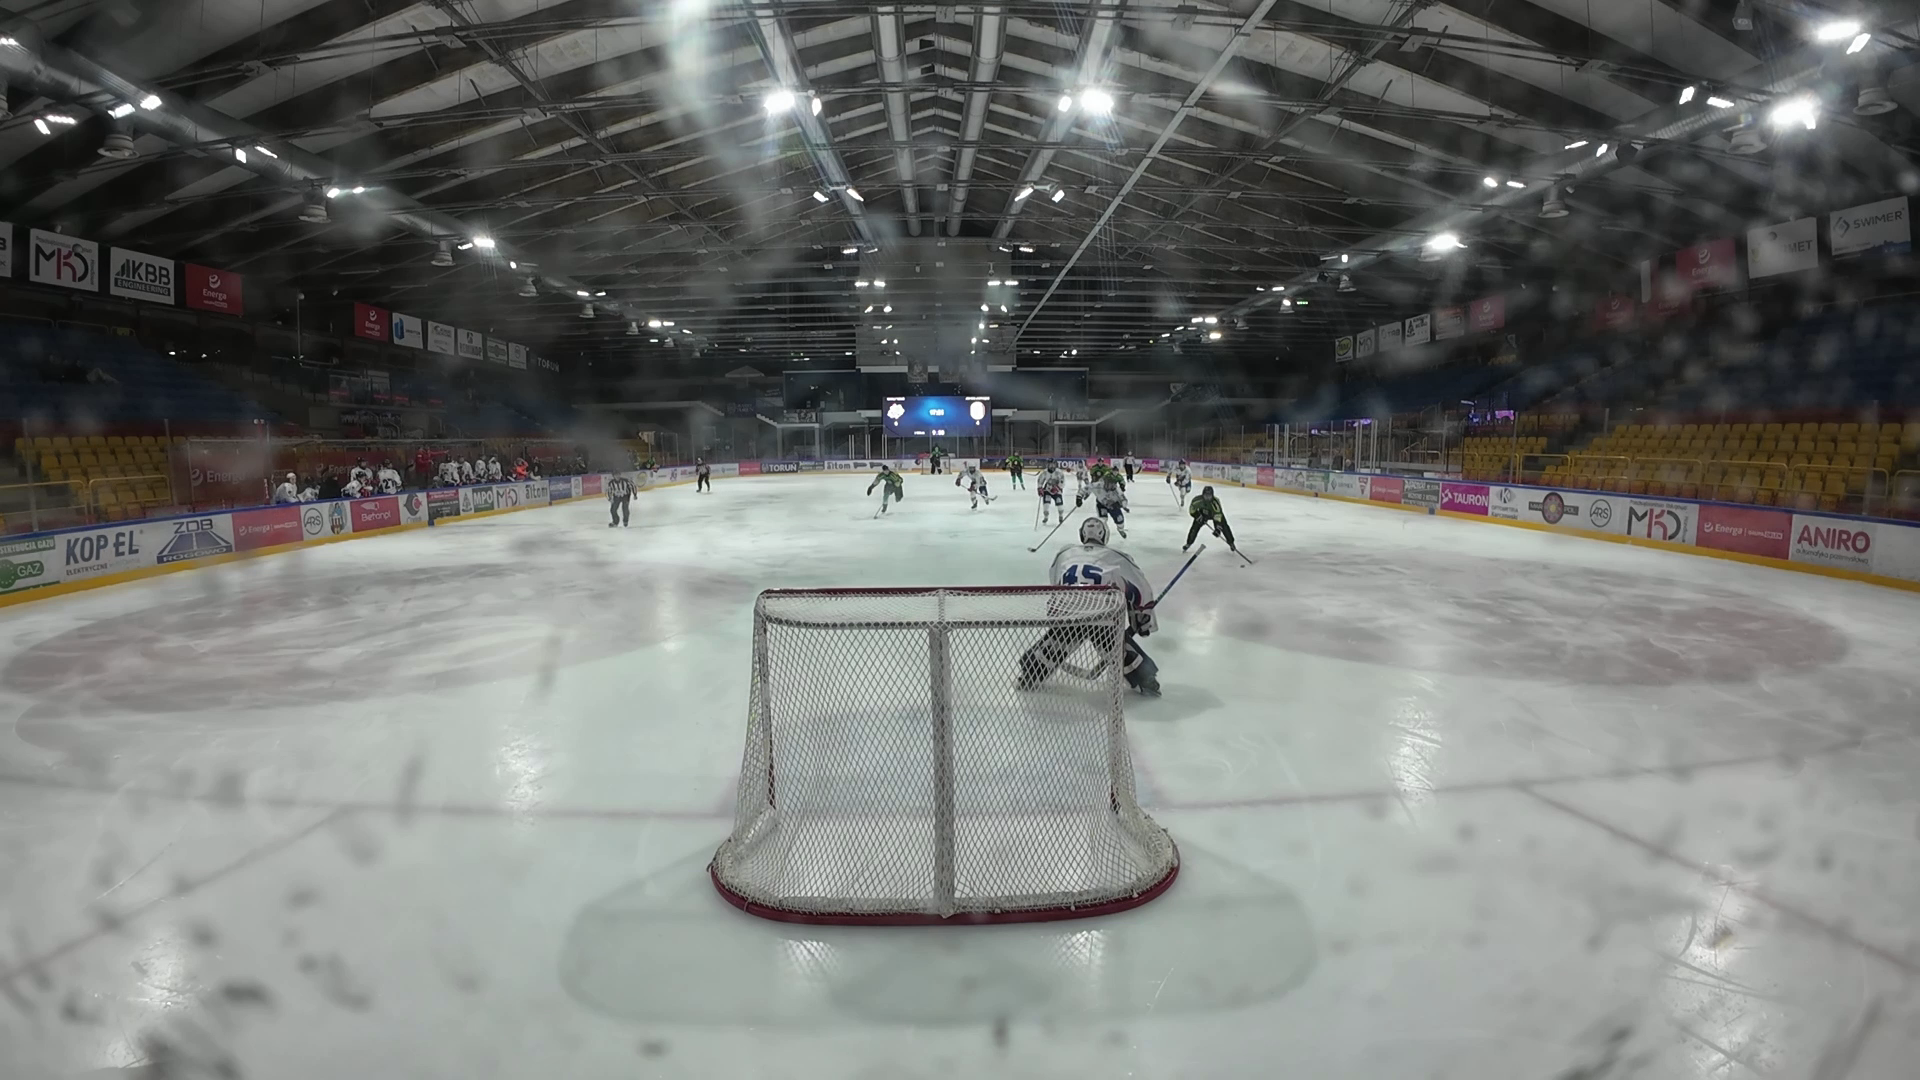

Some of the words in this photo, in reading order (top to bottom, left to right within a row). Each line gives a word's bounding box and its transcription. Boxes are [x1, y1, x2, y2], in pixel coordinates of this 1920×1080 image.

[1853, 211, 1903, 229] SWIMER
[35, 243, 89, 282] MKD
[117, 280, 169, 295] ENGINEERING
[203, 289, 227, 301] Energa
[769, 461, 797, 472] TORUŃ
[1057, 461, 1086, 469] TORU
[474, 490, 493, 506] MPO
[1453, 492, 1489, 507] TAURON
[1591, 507, 1609, 519] ARS
[172, 518, 214, 535] ZDB
[305, 515, 321, 527] ARS
[1627, 506, 1681, 540] MKD
[248, 524, 270, 534] Energa
[1715, 523, 1743, 537] Energa
[1797, 524, 1871, 554] ANIRO
[163, 547, 227, 562] ROGOWO
[17, 563, 42, 577] GAZ
[66, 563, 108, 576] ELEKTRYCZNE
[1062, 564, 1103, 585] 45
